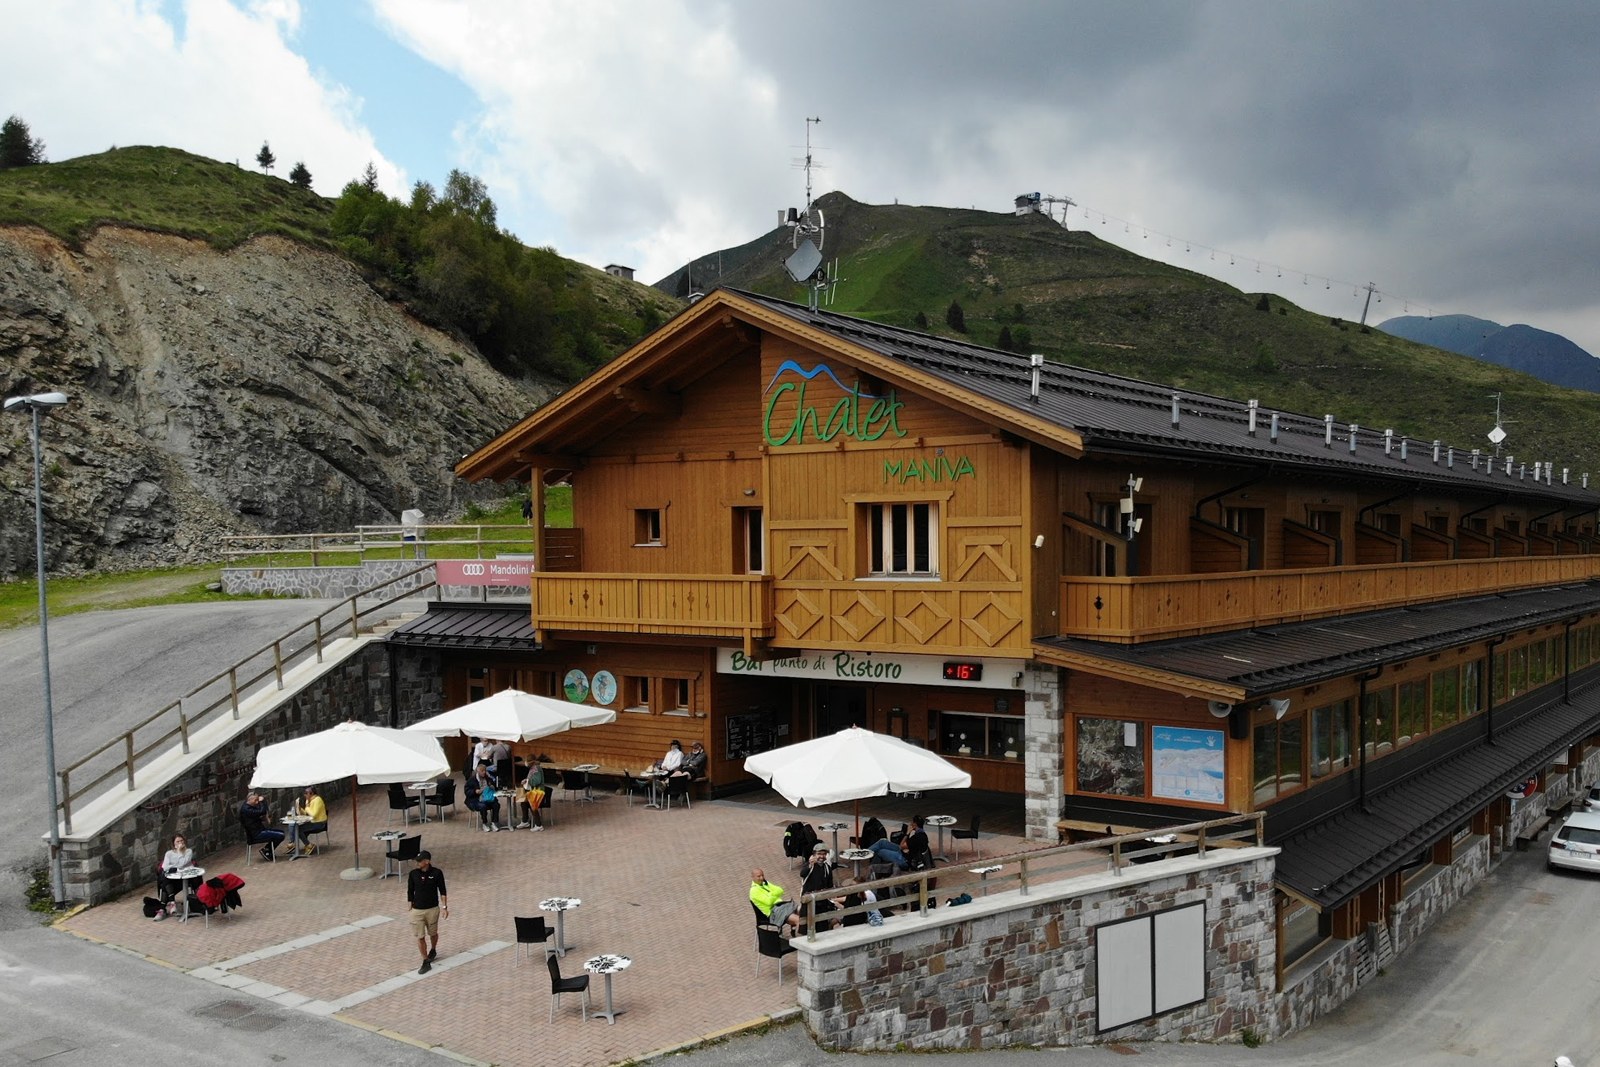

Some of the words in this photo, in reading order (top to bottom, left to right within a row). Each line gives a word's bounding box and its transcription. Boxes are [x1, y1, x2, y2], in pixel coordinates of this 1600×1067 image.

[764, 380, 908, 446] Chalet
[884, 456, 975, 484] MANIVA
[490, 564, 529, 575] Mandolini
[772, 656, 808, 673] punto
[813, 655, 826, 670] di
[832, 652, 902, 679] Ristoro
